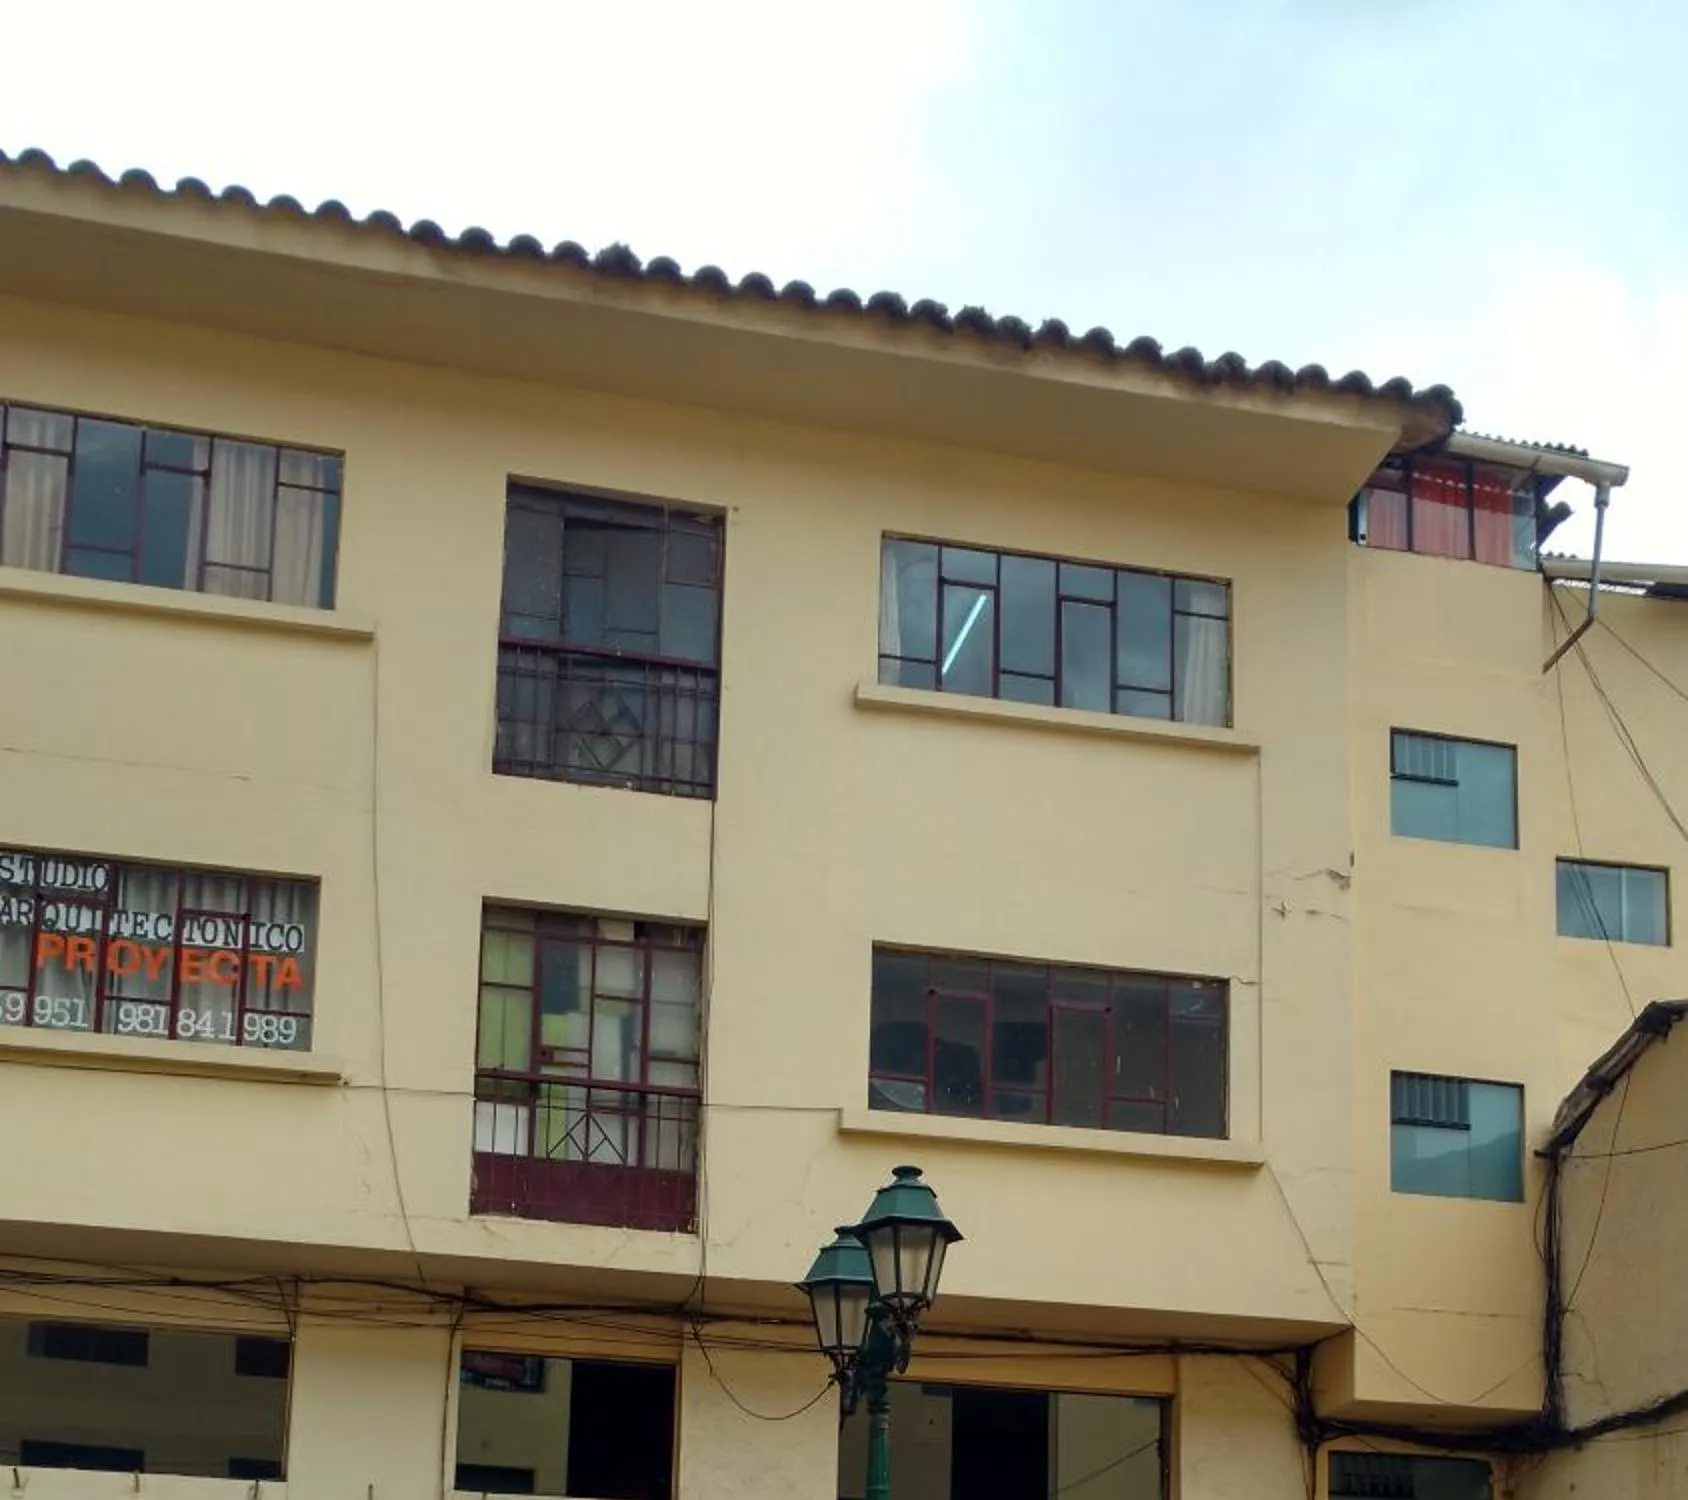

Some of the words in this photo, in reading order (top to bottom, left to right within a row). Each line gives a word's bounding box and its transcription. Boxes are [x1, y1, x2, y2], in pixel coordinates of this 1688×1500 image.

[36, 932, 303, 991] PROYECTA
[33, 995, 89, 1028] 951
[118, 1003, 169, 1035] 981
[177, 1009, 236, 1040] 841
[243, 1013, 297, 1044] 989
